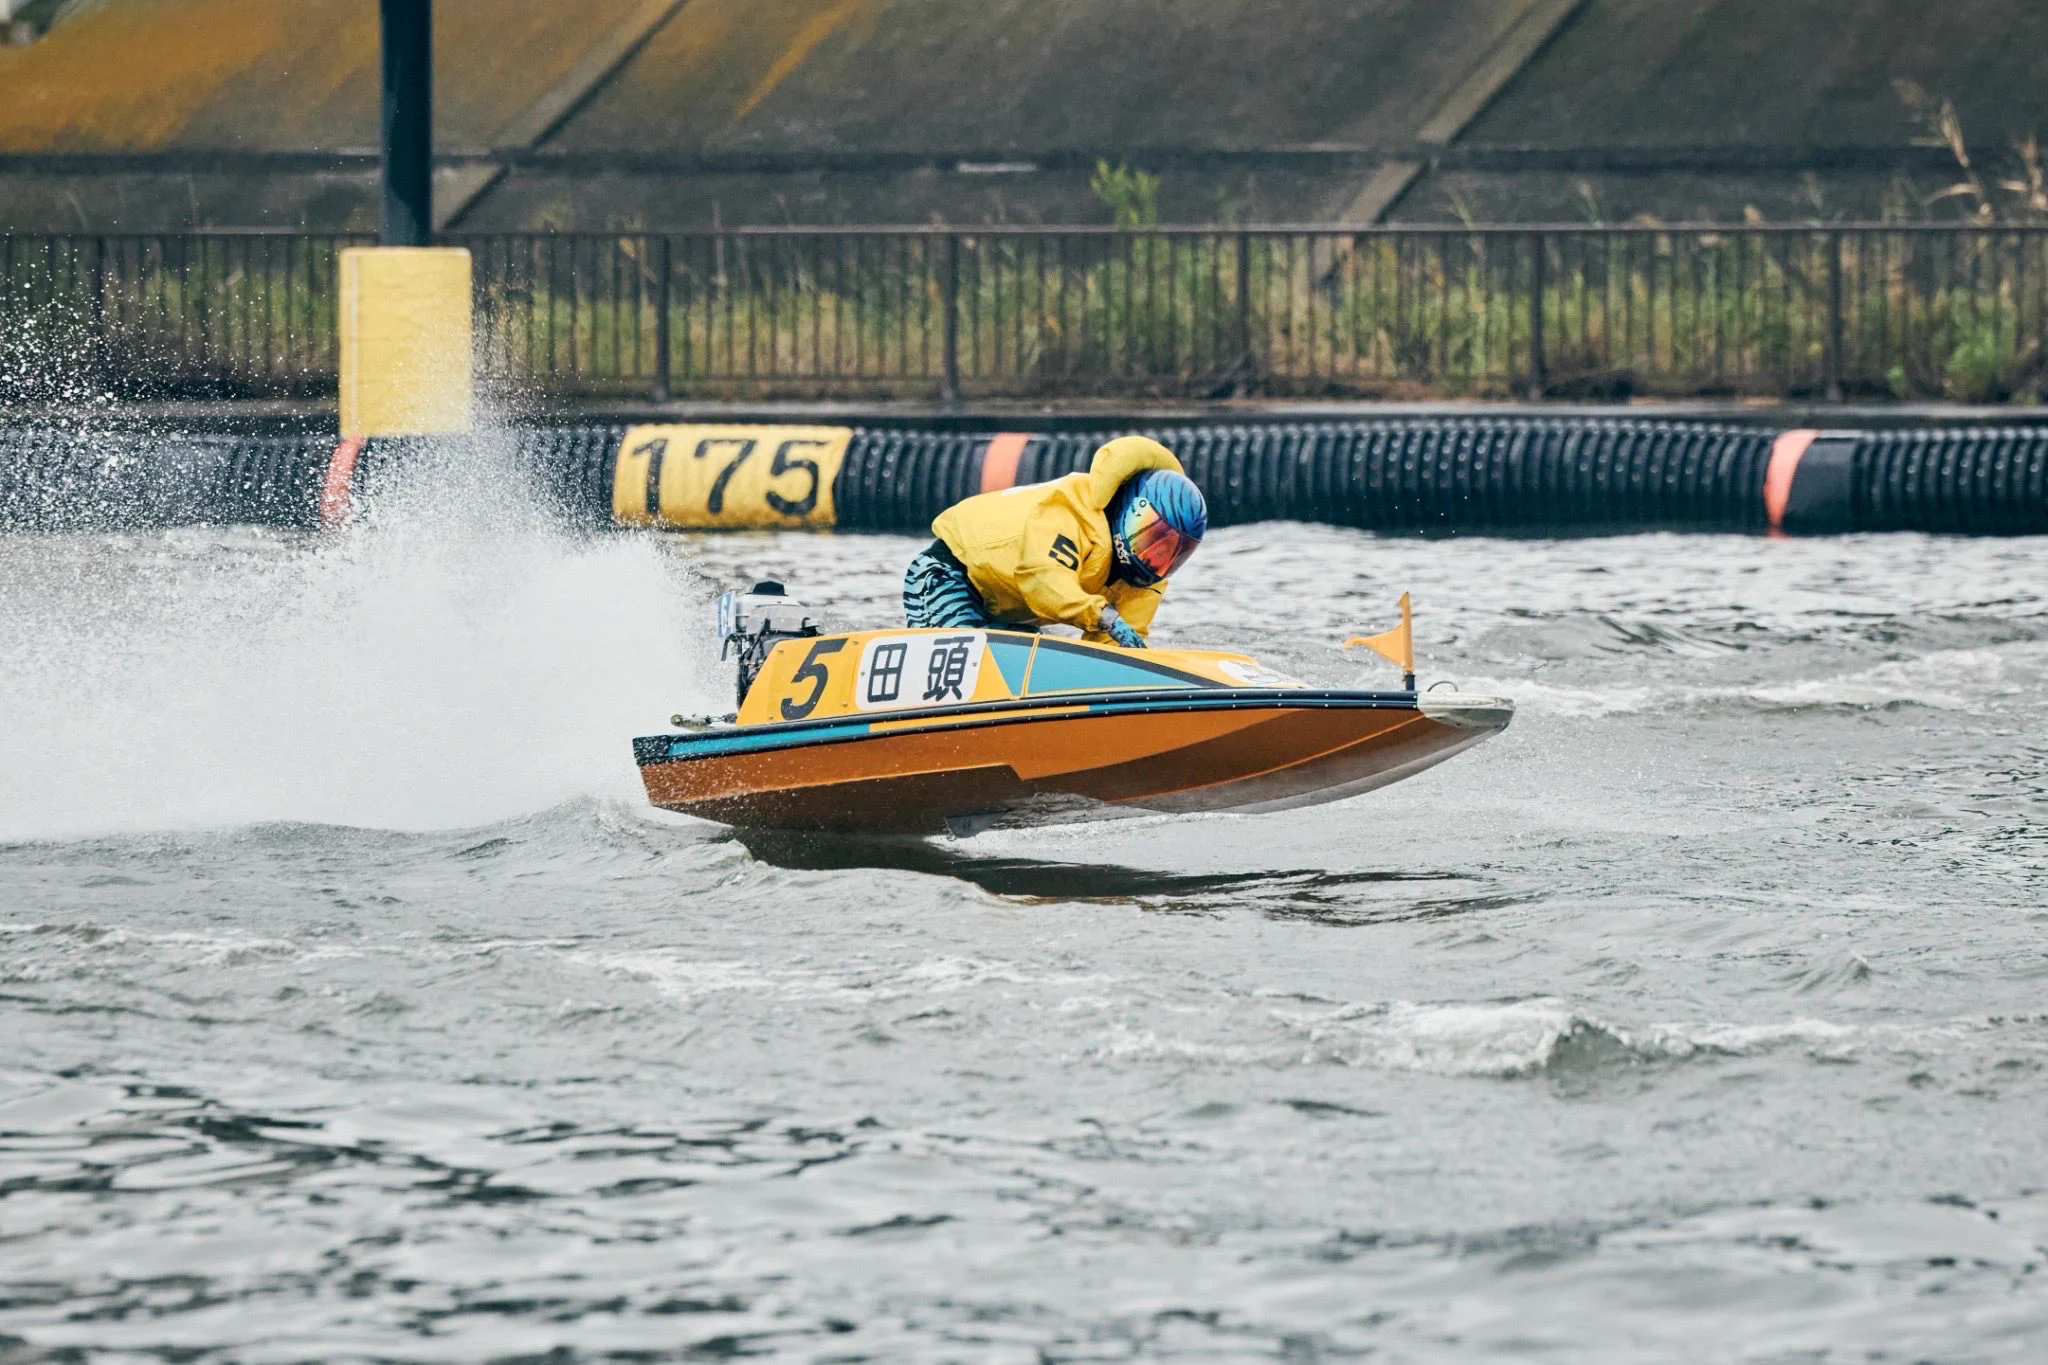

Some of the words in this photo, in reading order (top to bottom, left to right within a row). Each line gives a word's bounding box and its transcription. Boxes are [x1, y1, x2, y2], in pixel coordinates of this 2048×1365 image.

[632, 437, 832, 516] 175
[1048, 533, 1080, 572] 5
[780, 638, 848, 721] 5
[867, 636, 975, 703] 田頭
